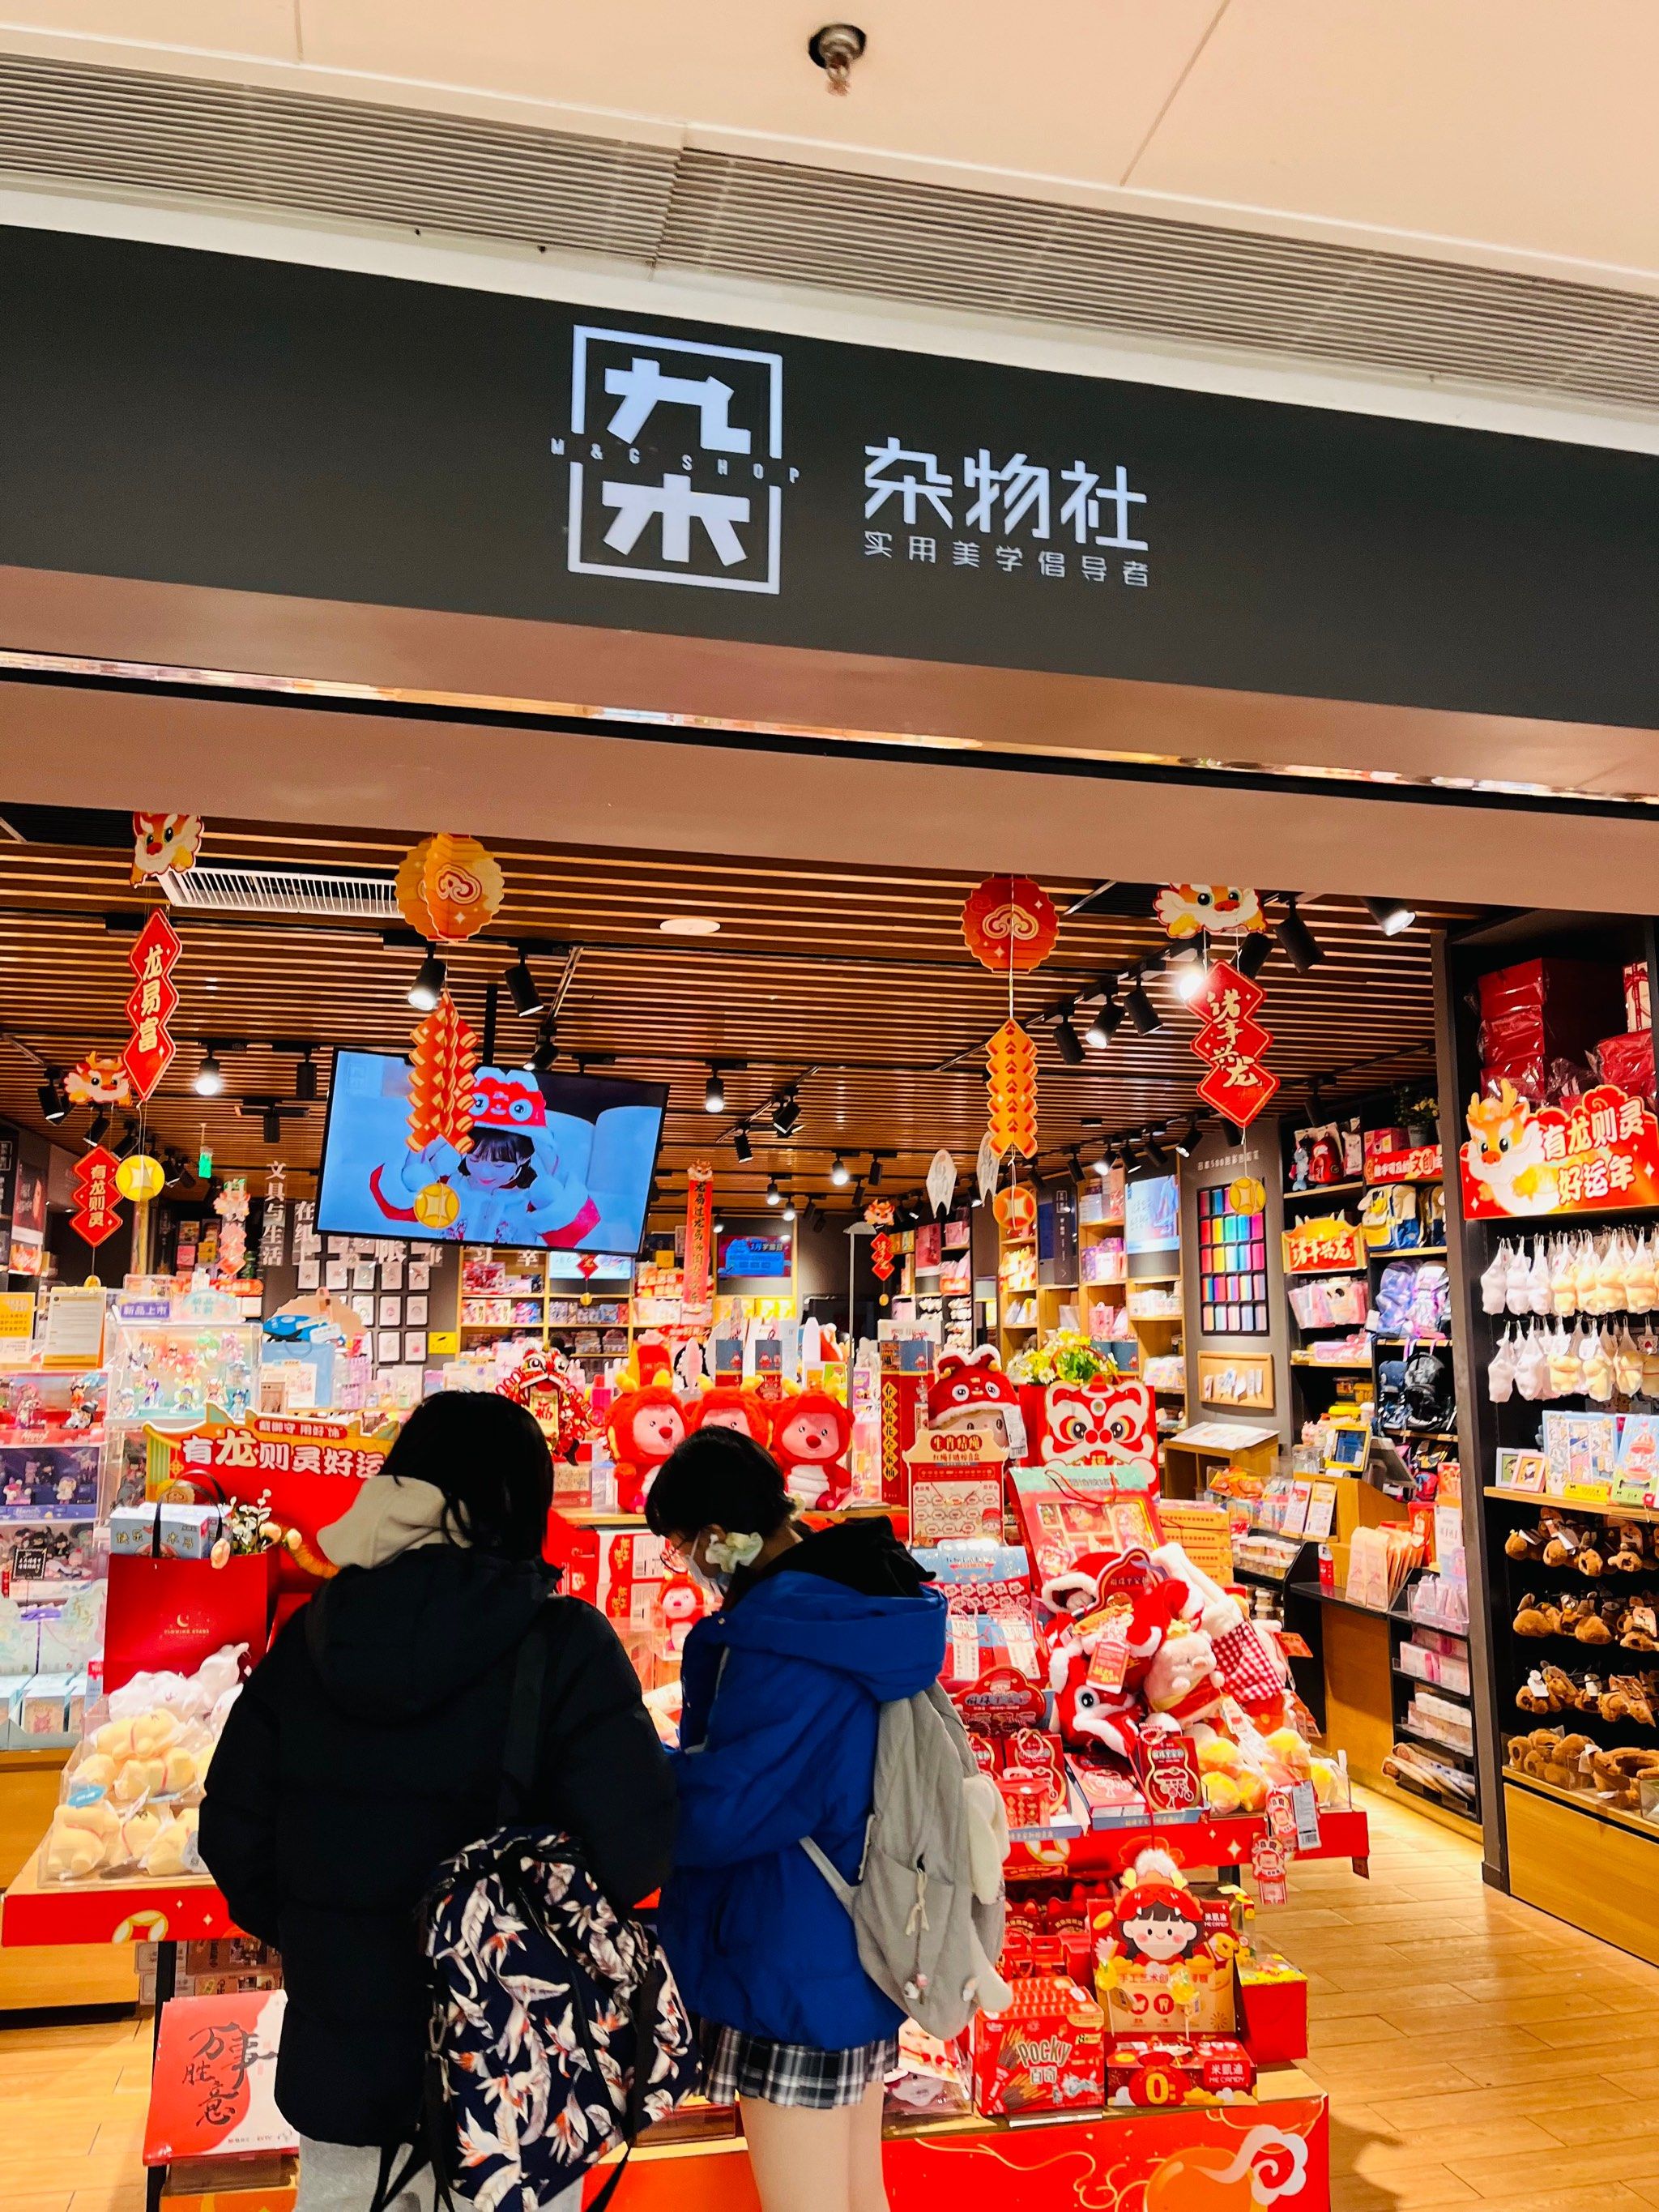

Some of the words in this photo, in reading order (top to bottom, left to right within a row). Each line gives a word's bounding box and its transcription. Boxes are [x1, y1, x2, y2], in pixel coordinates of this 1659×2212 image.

[681, 455, 800, 483] SHOP
[864, 436, 1149, 552] 杂物社
[864, 530, 1149, 587] 实用美学倡导者
[138, 945, 164, 1054] 龙易富
[1545, 1100, 1645, 1161] 有龙则灵
[89, 1164, 107, 1229] 有龙则灵
[1558, 1154, 1636, 1205] 好运年
[262, 1160, 287, 1266] 文具与生活
[123, 1305, 168, 1317] 新品上市
[1030, 2065, 1057, 2086] 百奇
